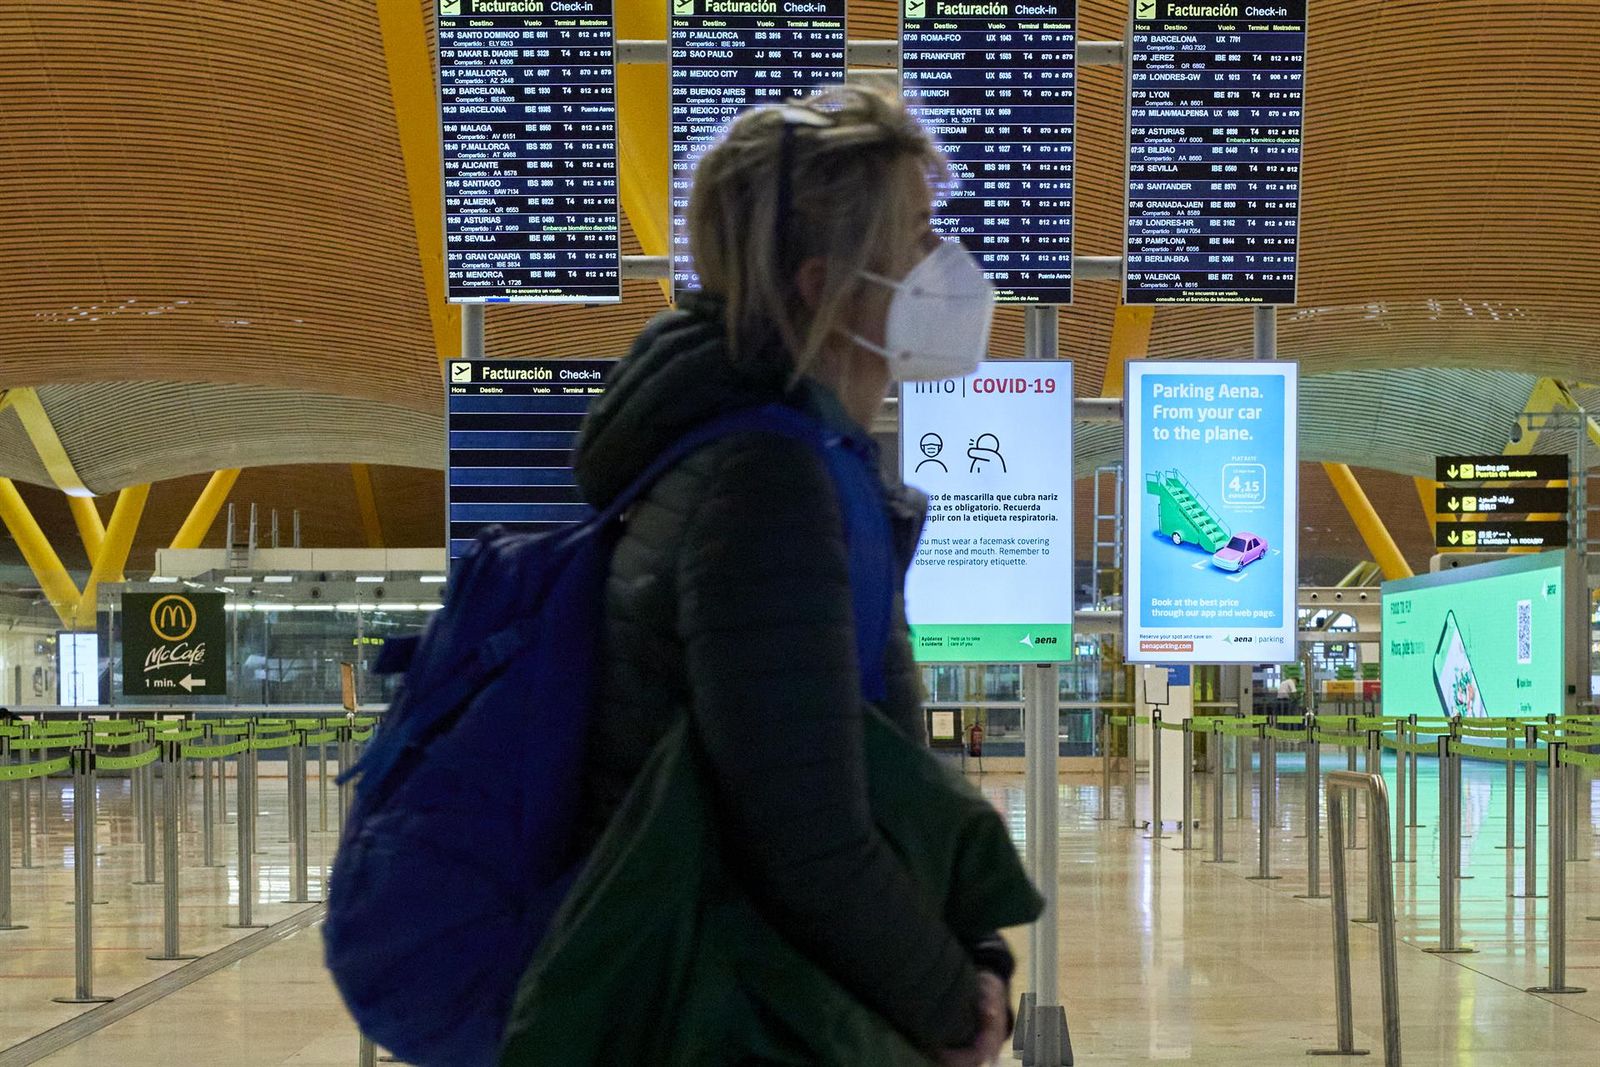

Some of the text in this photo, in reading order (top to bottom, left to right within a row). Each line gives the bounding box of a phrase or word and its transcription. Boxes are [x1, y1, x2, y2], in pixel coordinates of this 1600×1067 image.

[471, 0, 593, 12] Facturación Check-in
[706, 0, 826, 12] Facturación Check-in
[937, 2, 1057, 15] Facturación Check-in
[1168, 3, 1287, 16] Facturación Check-in
[483, 367, 601, 380] Facturación Check-in
[973, 378, 1055, 393] COVID-19
[1153, 384, 1263, 401] Parking Aena.
[1153, 405, 1262, 422] From your car
[1153, 426, 1253, 443] to the plane.
[942, 493, 951, 501] de
[954, 493, 994, 501] mascarilla
[997, 495, 1011, 503] que
[1014, 493, 1036, 501] cubra
[1038, 493, 1058, 501] nariz
[955, 504, 1001, 513] obligatorio.
[925, 514, 945, 523] mplir
[973, 514, 1007, 523] etiqueta
[1009, 514, 1058, 523] respiratoria.
[1018, 538, 1049, 546] covering
[948, 558, 988, 567] respiratory
[991, 558, 1027, 567] etiquette.
[1219, 599, 1239, 607] price
[1152, 609, 1184, 618] through
[1201, 610, 1216, 618] app
[1218, 609, 1233, 617] and
[1235, 609, 1252, 617] web
[1254, 610, 1275, 618] page.
[1259, 636, 1284, 644] parking
[1142, 642, 1192, 650] aenaparking.com
[144, 642, 205, 672] McCafé
[145, 678, 176, 687] 1 min.
